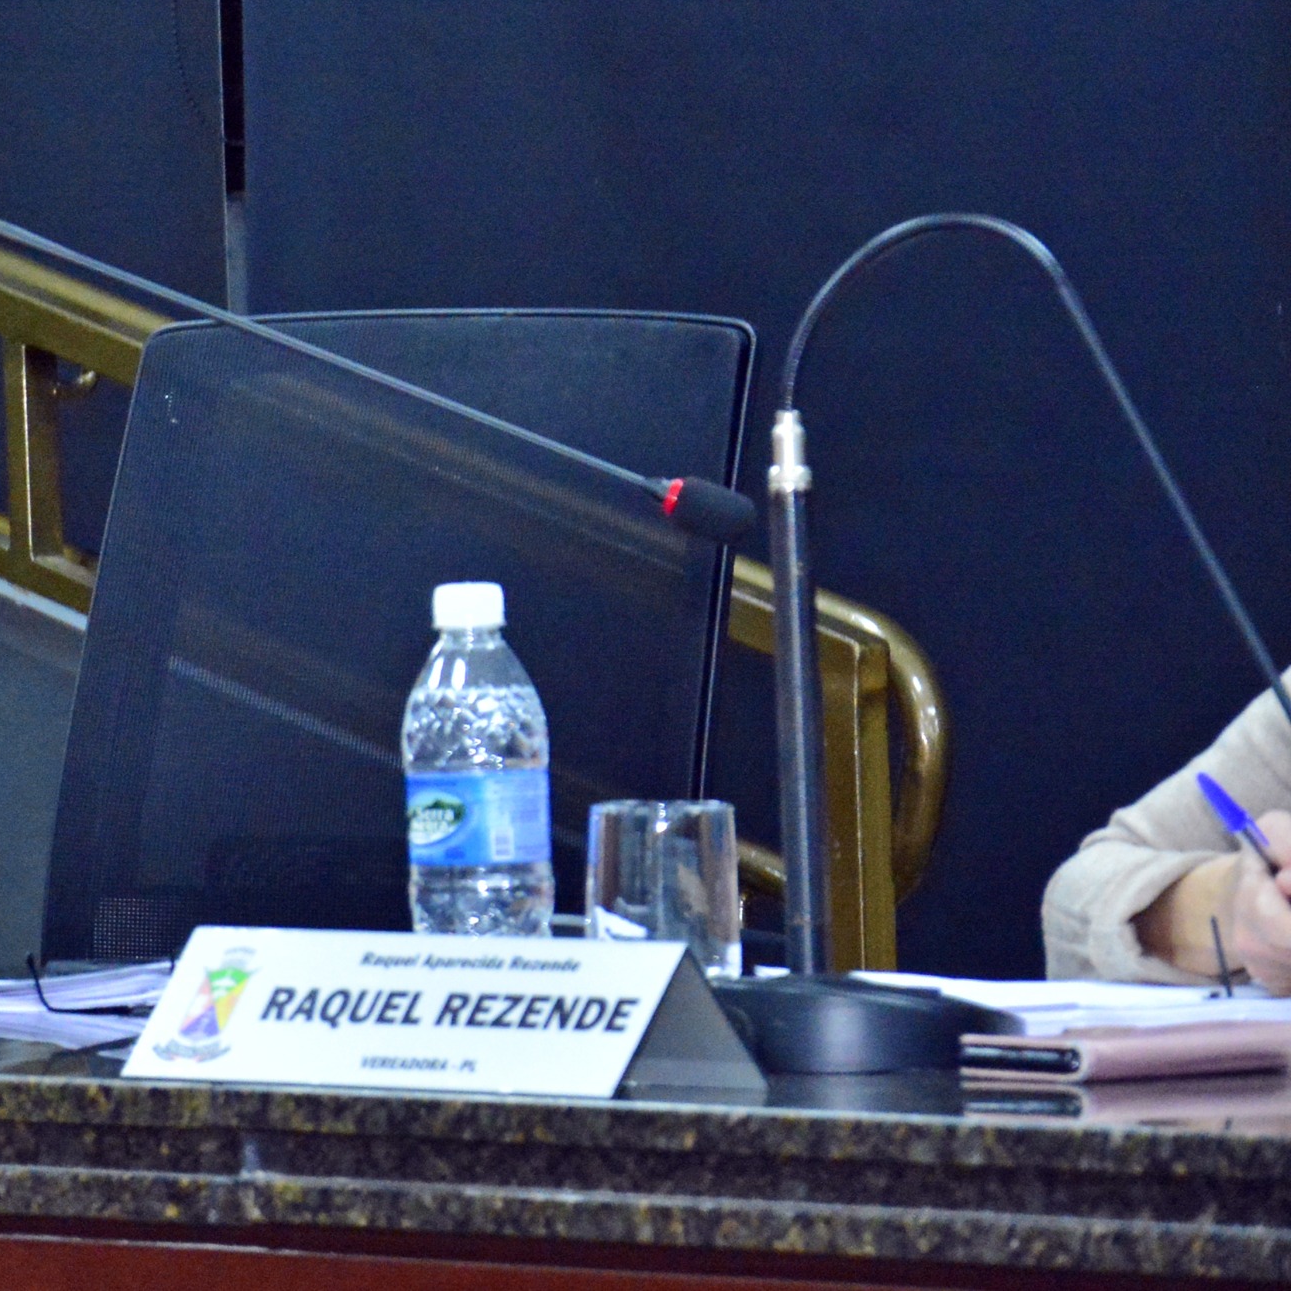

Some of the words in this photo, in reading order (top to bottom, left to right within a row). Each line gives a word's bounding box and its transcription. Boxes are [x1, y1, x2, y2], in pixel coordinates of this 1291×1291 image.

[360, 951, 421, 969] Raquel
[421, 952, 505, 971] Aparecida
[508, 955, 581, 972] Rezende
[260, 986, 423, 1030] RAQUEL
[434, 992, 639, 1034] REZENDE
[360, 1056, 448, 1071] VEREADORA
